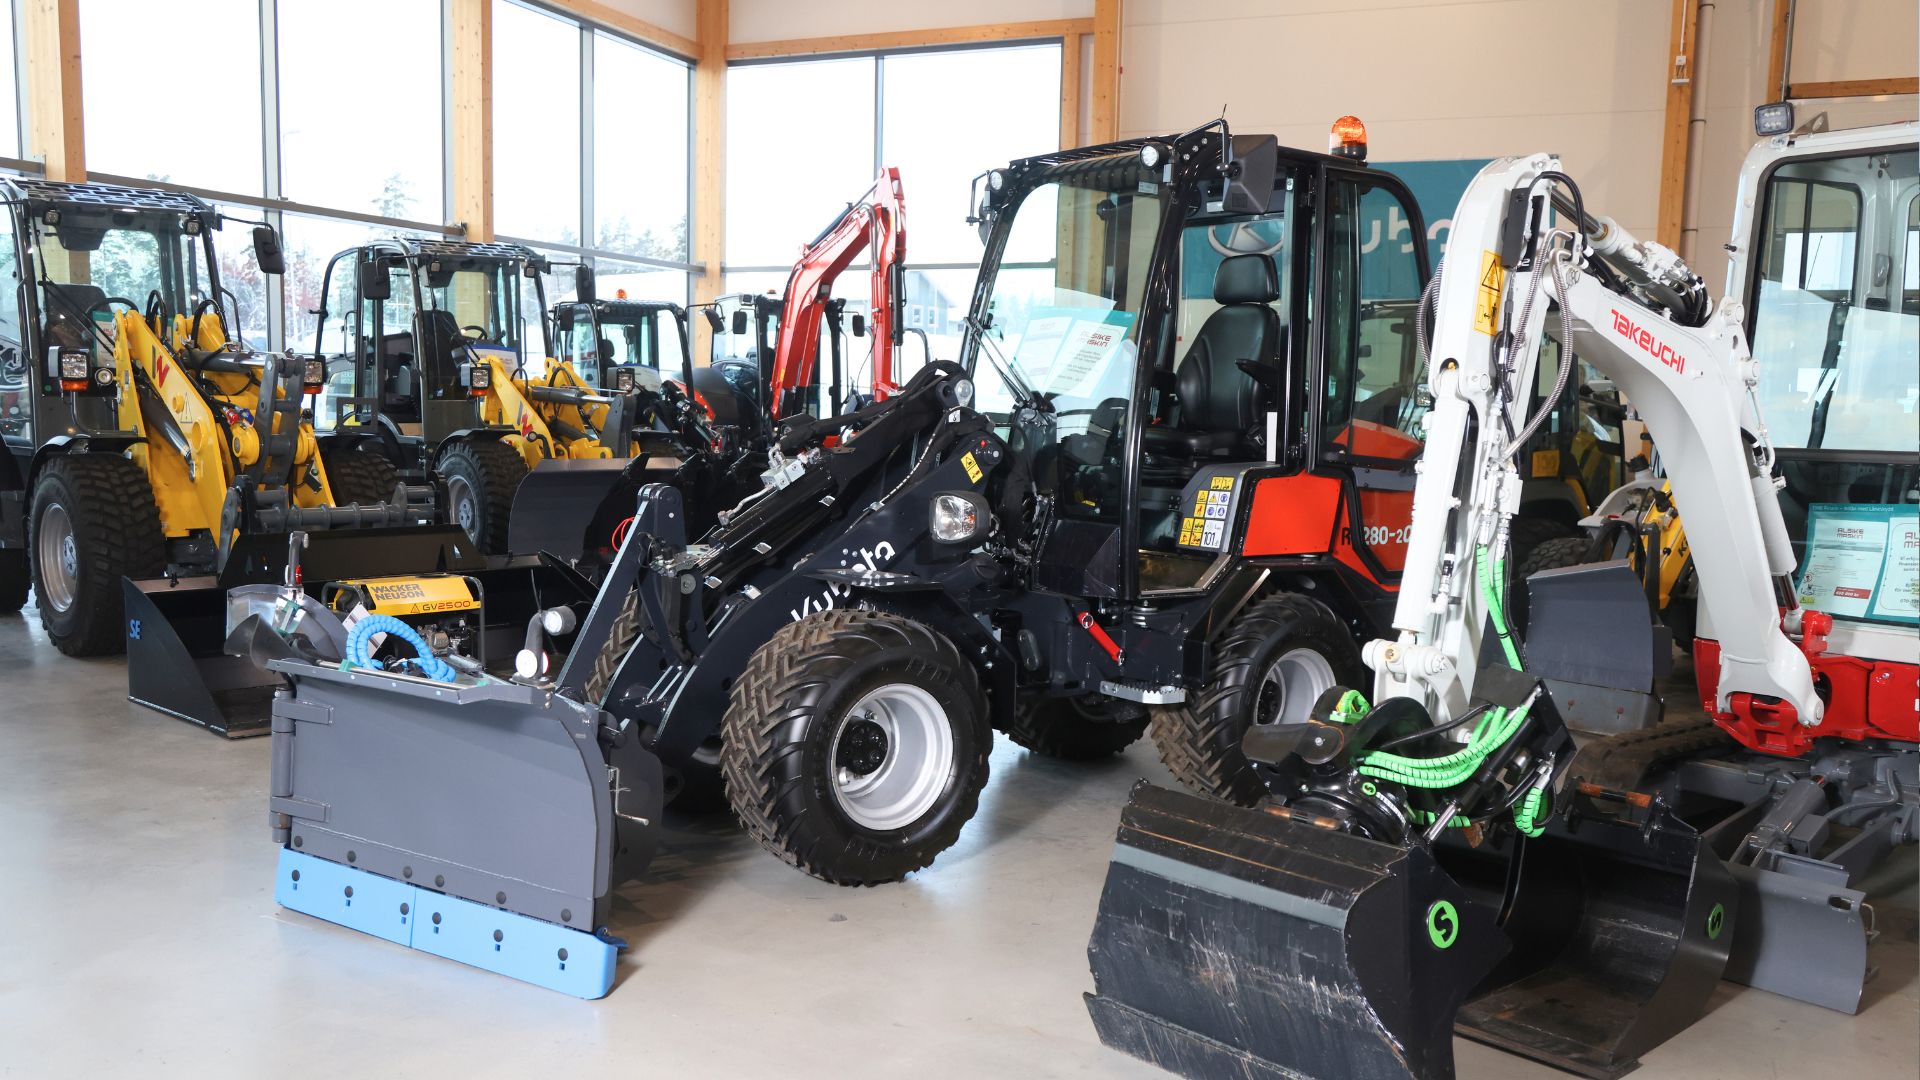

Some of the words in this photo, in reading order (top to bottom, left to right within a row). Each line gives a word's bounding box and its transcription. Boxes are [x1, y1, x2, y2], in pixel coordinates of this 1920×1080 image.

[370, 583, 421, 594] WACKER
[375, 590, 425, 601] NEUSON
[422, 600, 471, 612] GV2500
[130, 619, 141, 640] SE
